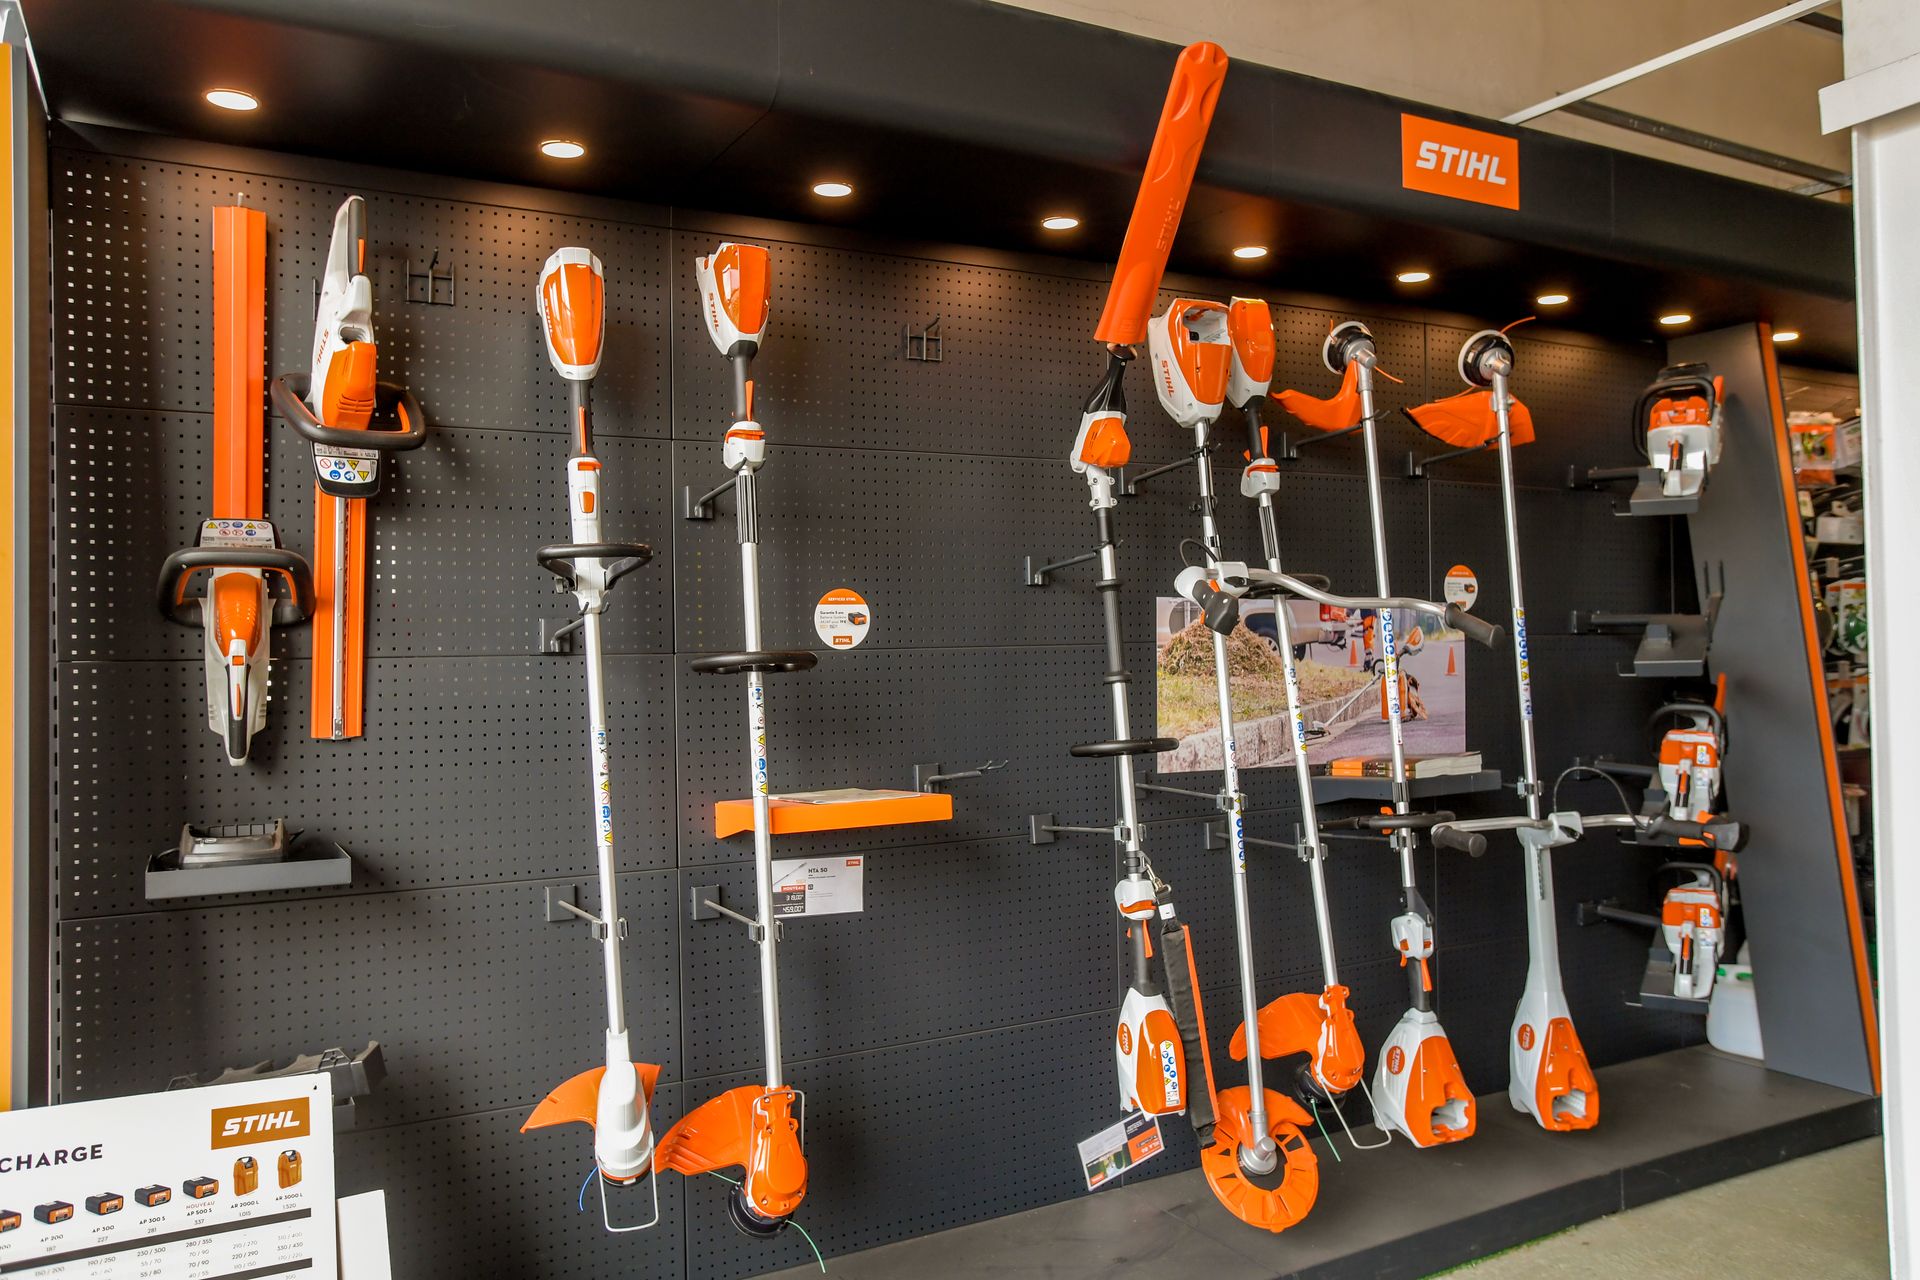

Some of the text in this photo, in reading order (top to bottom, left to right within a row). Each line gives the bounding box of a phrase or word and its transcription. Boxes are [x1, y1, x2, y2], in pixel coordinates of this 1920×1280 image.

[1415, 140, 1507, 185] STIHL
[1156, 197, 1181, 252] STIHL
[709, 292, 719, 332] STIHL
[317, 328, 329, 365] STIHL
[1162, 360, 1175, 398] STIHL
[221, 1110, 300, 1137] STIHL
[0, 1144, 103, 1173] CHARGE
[186, 1201, 216, 1209] NOUVEAU
